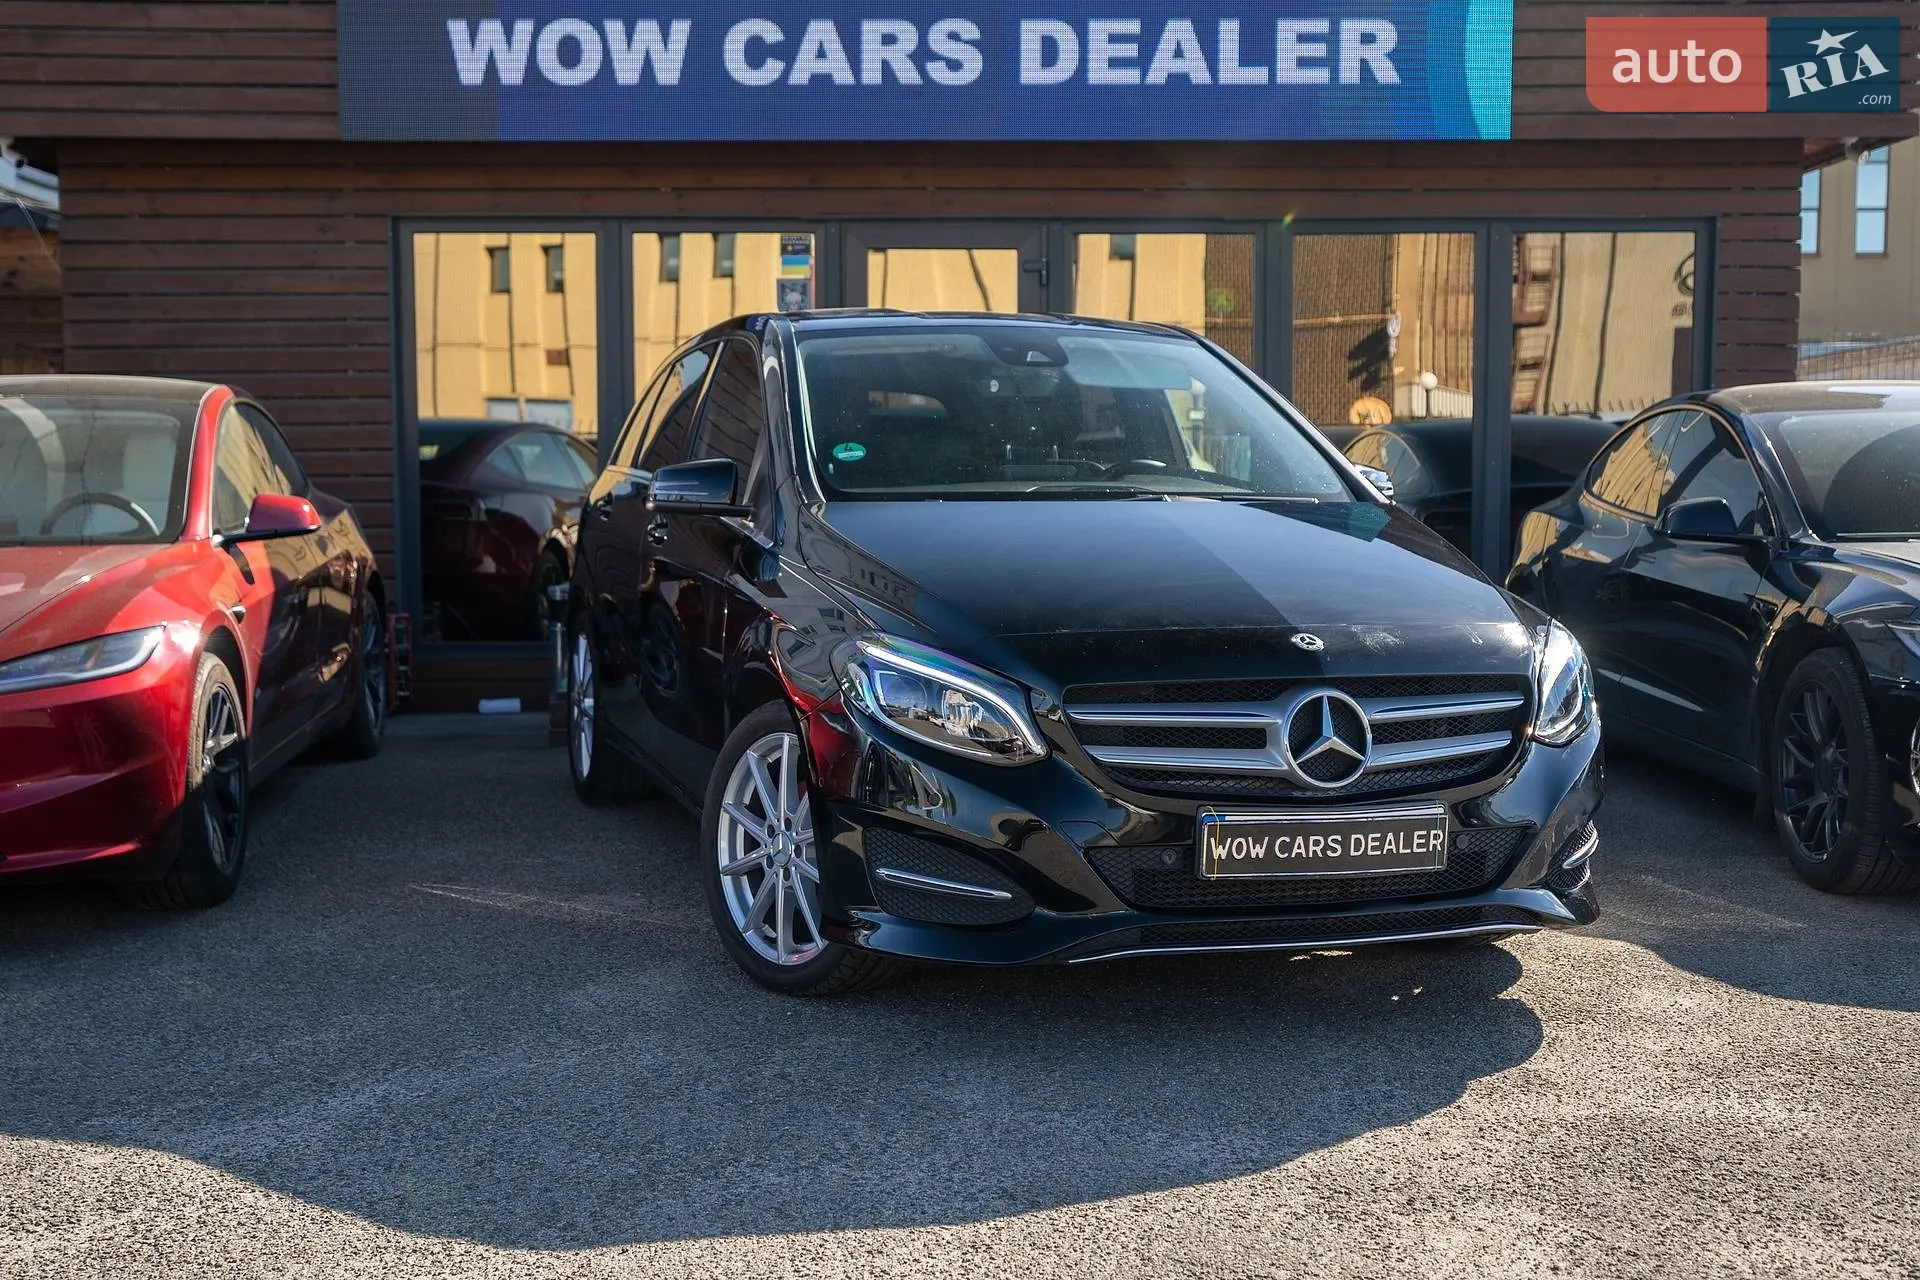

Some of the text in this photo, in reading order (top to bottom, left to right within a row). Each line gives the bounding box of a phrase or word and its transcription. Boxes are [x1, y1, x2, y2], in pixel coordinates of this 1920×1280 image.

[447, 18, 1401, 86] WOW CARS DEALER
[1210, 829, 1444, 860] WOW CARS DEALER
